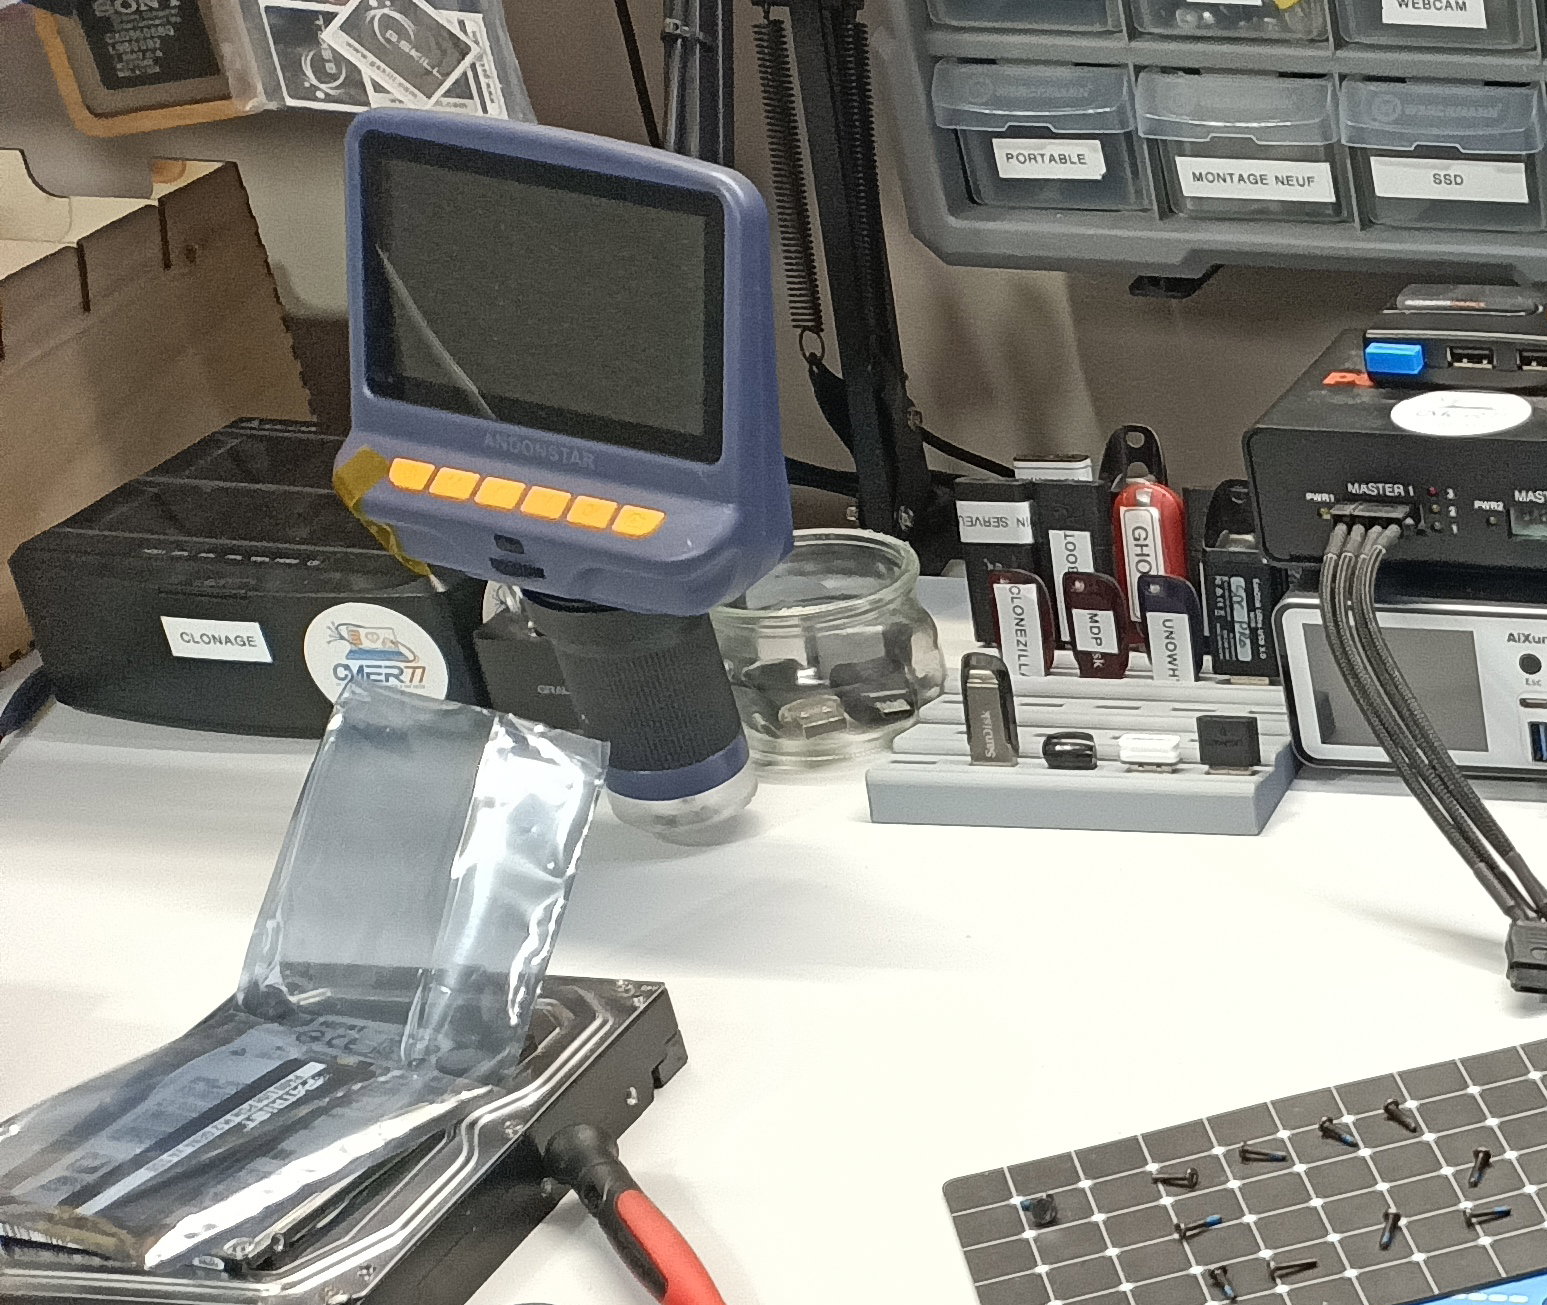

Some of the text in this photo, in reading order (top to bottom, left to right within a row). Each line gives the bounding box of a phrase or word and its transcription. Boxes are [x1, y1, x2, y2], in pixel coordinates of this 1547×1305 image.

[1005, 151, 1088, 166] PORTABLE
[1191, 170, 1317, 188] MONTAGE NEUF
[1432, 172, 1465, 187] SSD
[483, 431, 597, 471] ANDONSTAR
[1306, 491, 1335, 504] PWR1
[1347, 482, 1415, 498] MASTER 1
[1130, 525, 1153, 576] GHO
[1086, 612, 1104, 649] MDP
[179, 631, 258, 649] CLONAGE
[1161, 618, 1180, 682] UNOWH
[984, 711, 996, 758] SanDisk
